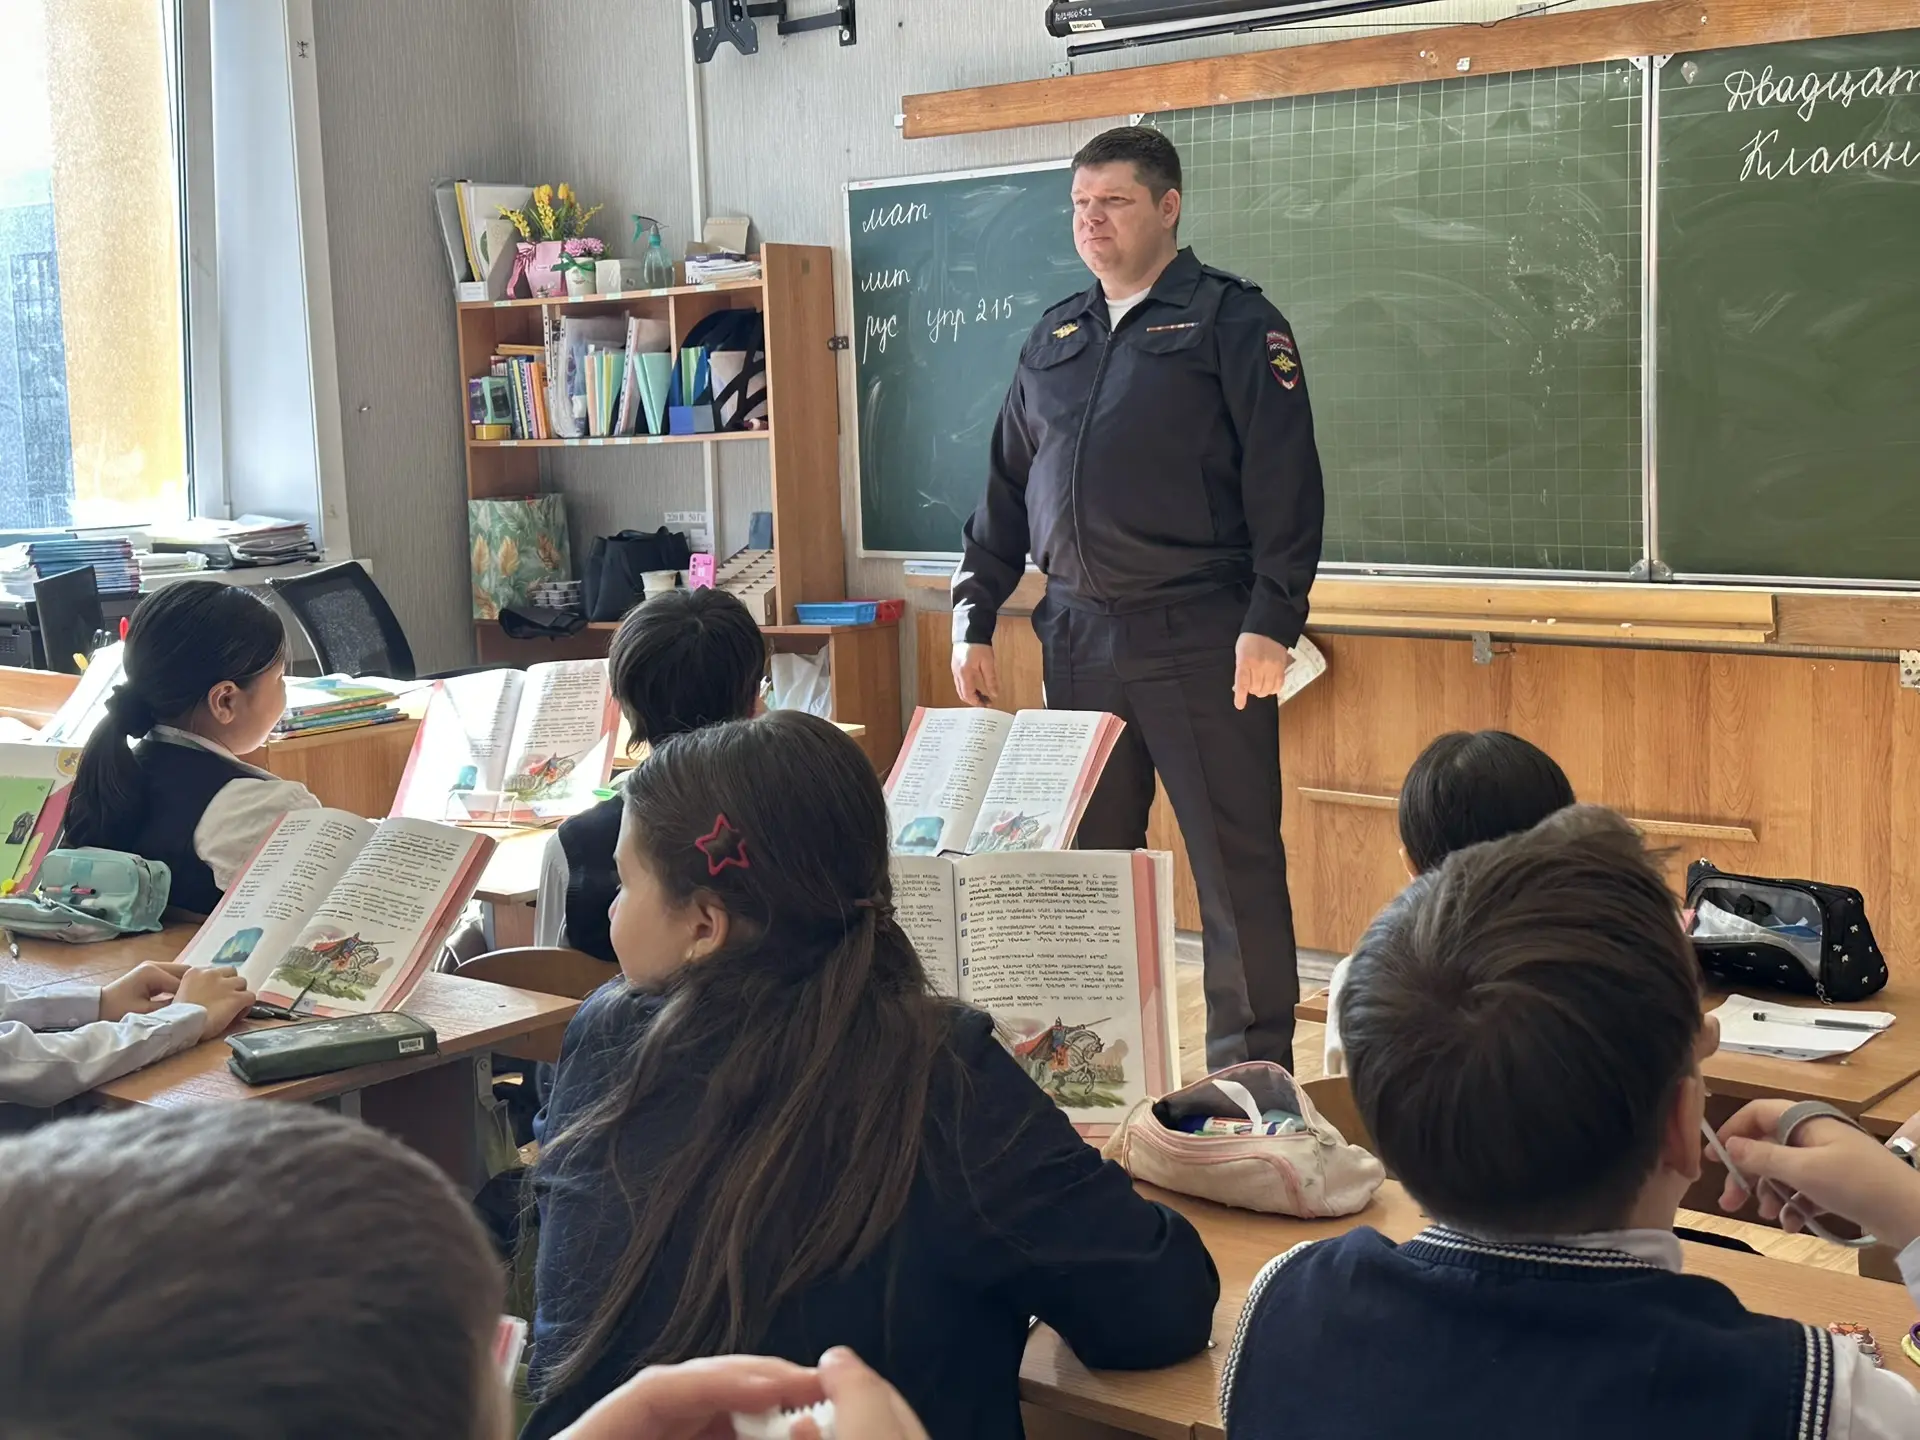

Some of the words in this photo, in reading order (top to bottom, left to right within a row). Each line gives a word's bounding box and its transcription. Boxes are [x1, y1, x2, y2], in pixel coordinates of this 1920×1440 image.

[861, 268, 911, 292] лит
[862, 314, 899, 365] рус
[926, 306, 966, 343] упр
[975, 294, 1015, 322] 215
